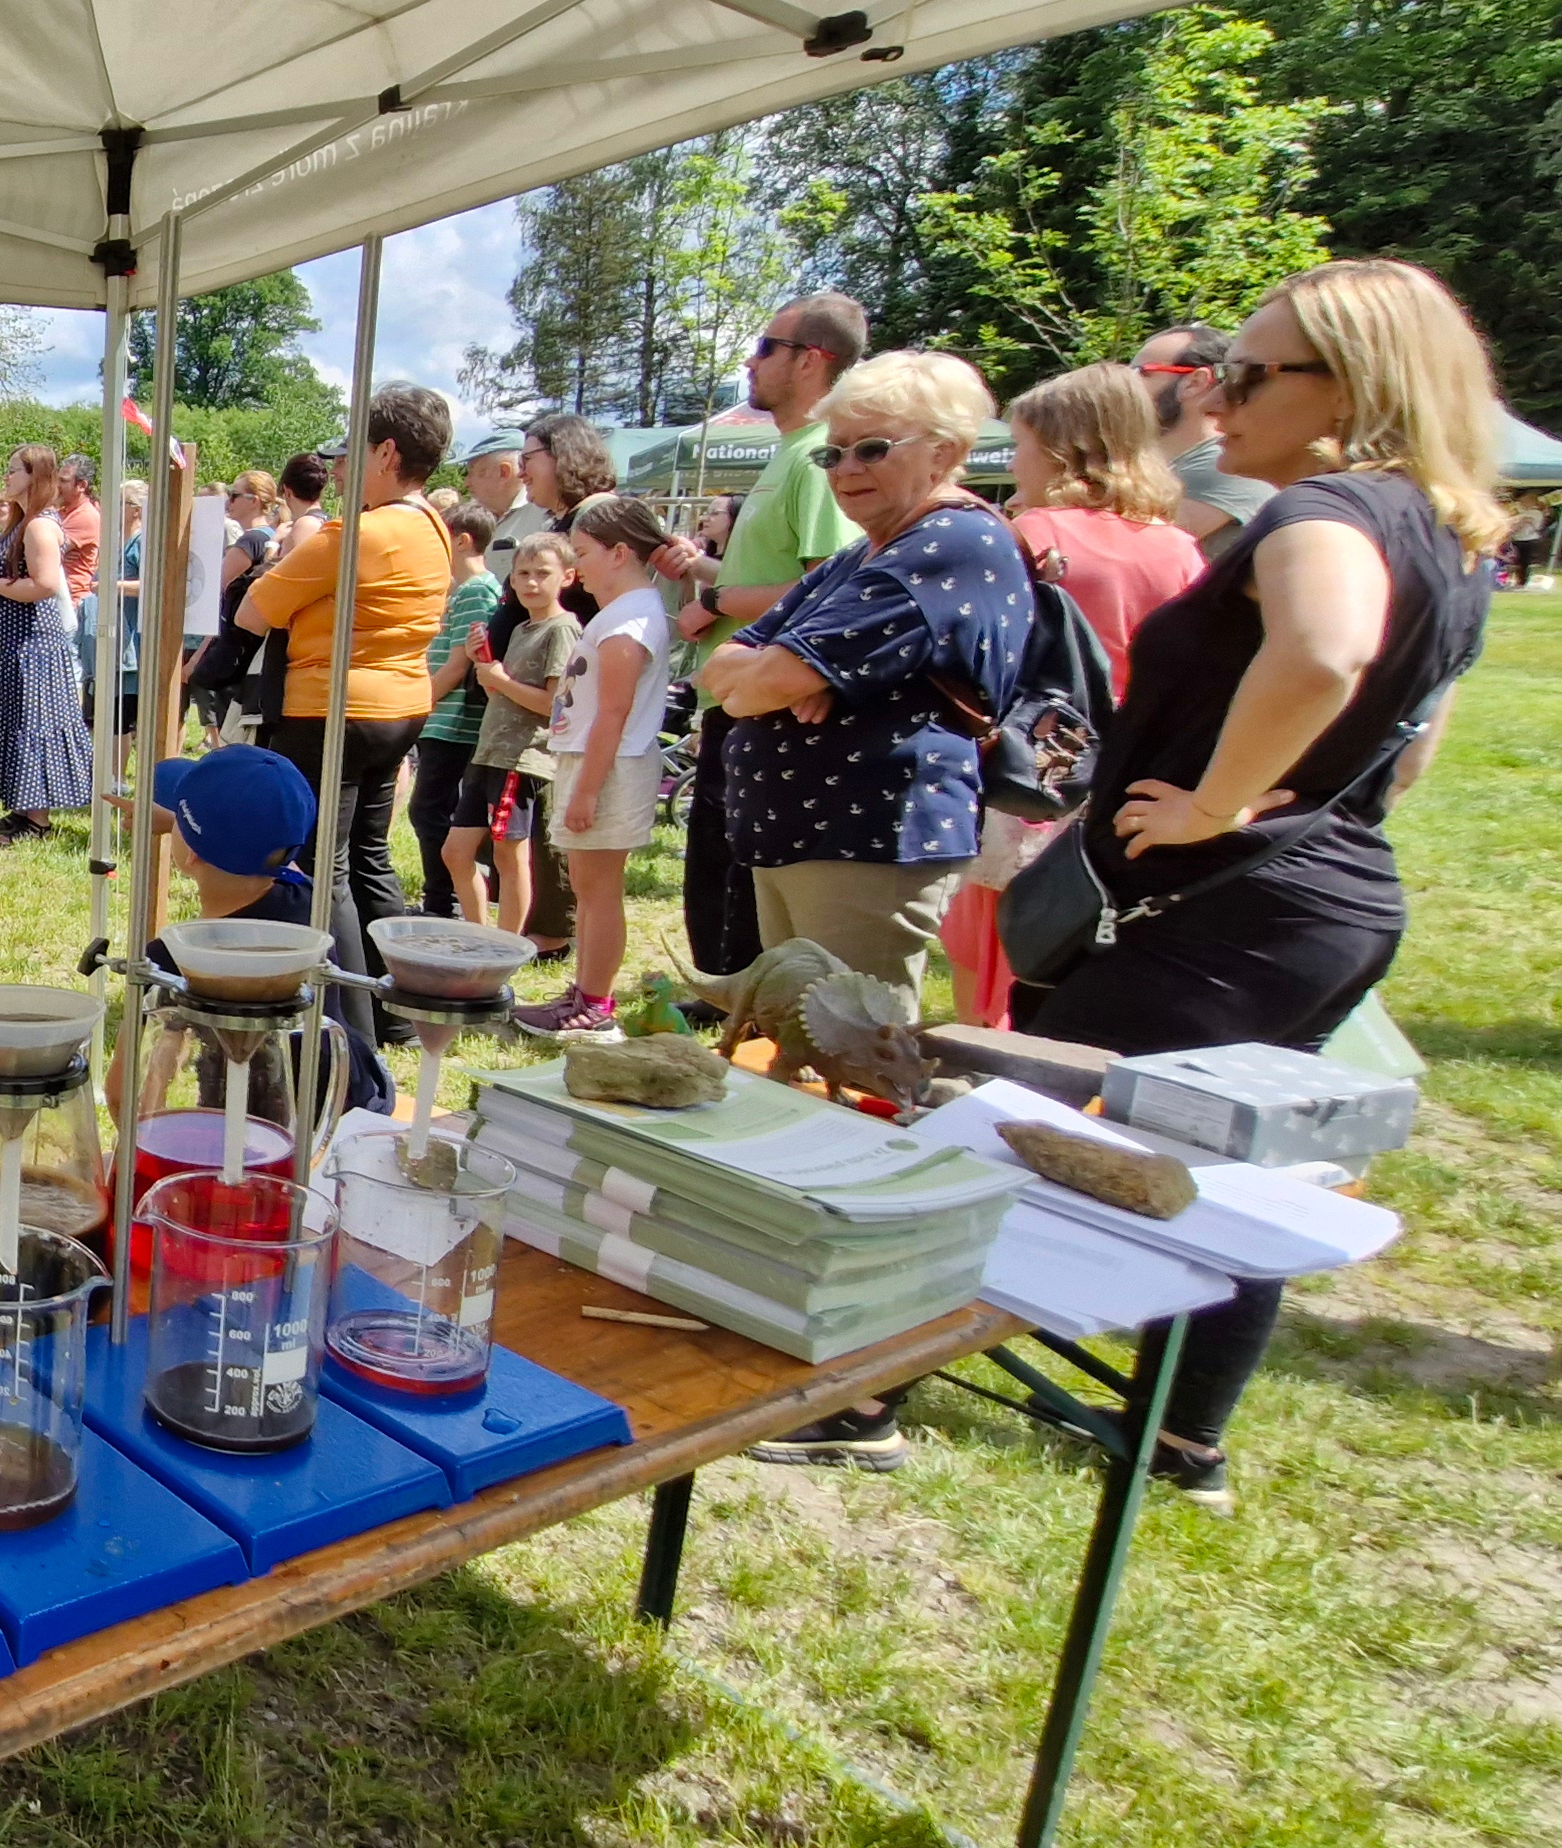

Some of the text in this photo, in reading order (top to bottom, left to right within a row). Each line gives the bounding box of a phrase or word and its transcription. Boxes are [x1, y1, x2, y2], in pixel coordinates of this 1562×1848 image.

[228, 1329, 251, 1341] 600
[226, 1367, 249, 1380] 400
[224, 1405, 246, 1417] 200
